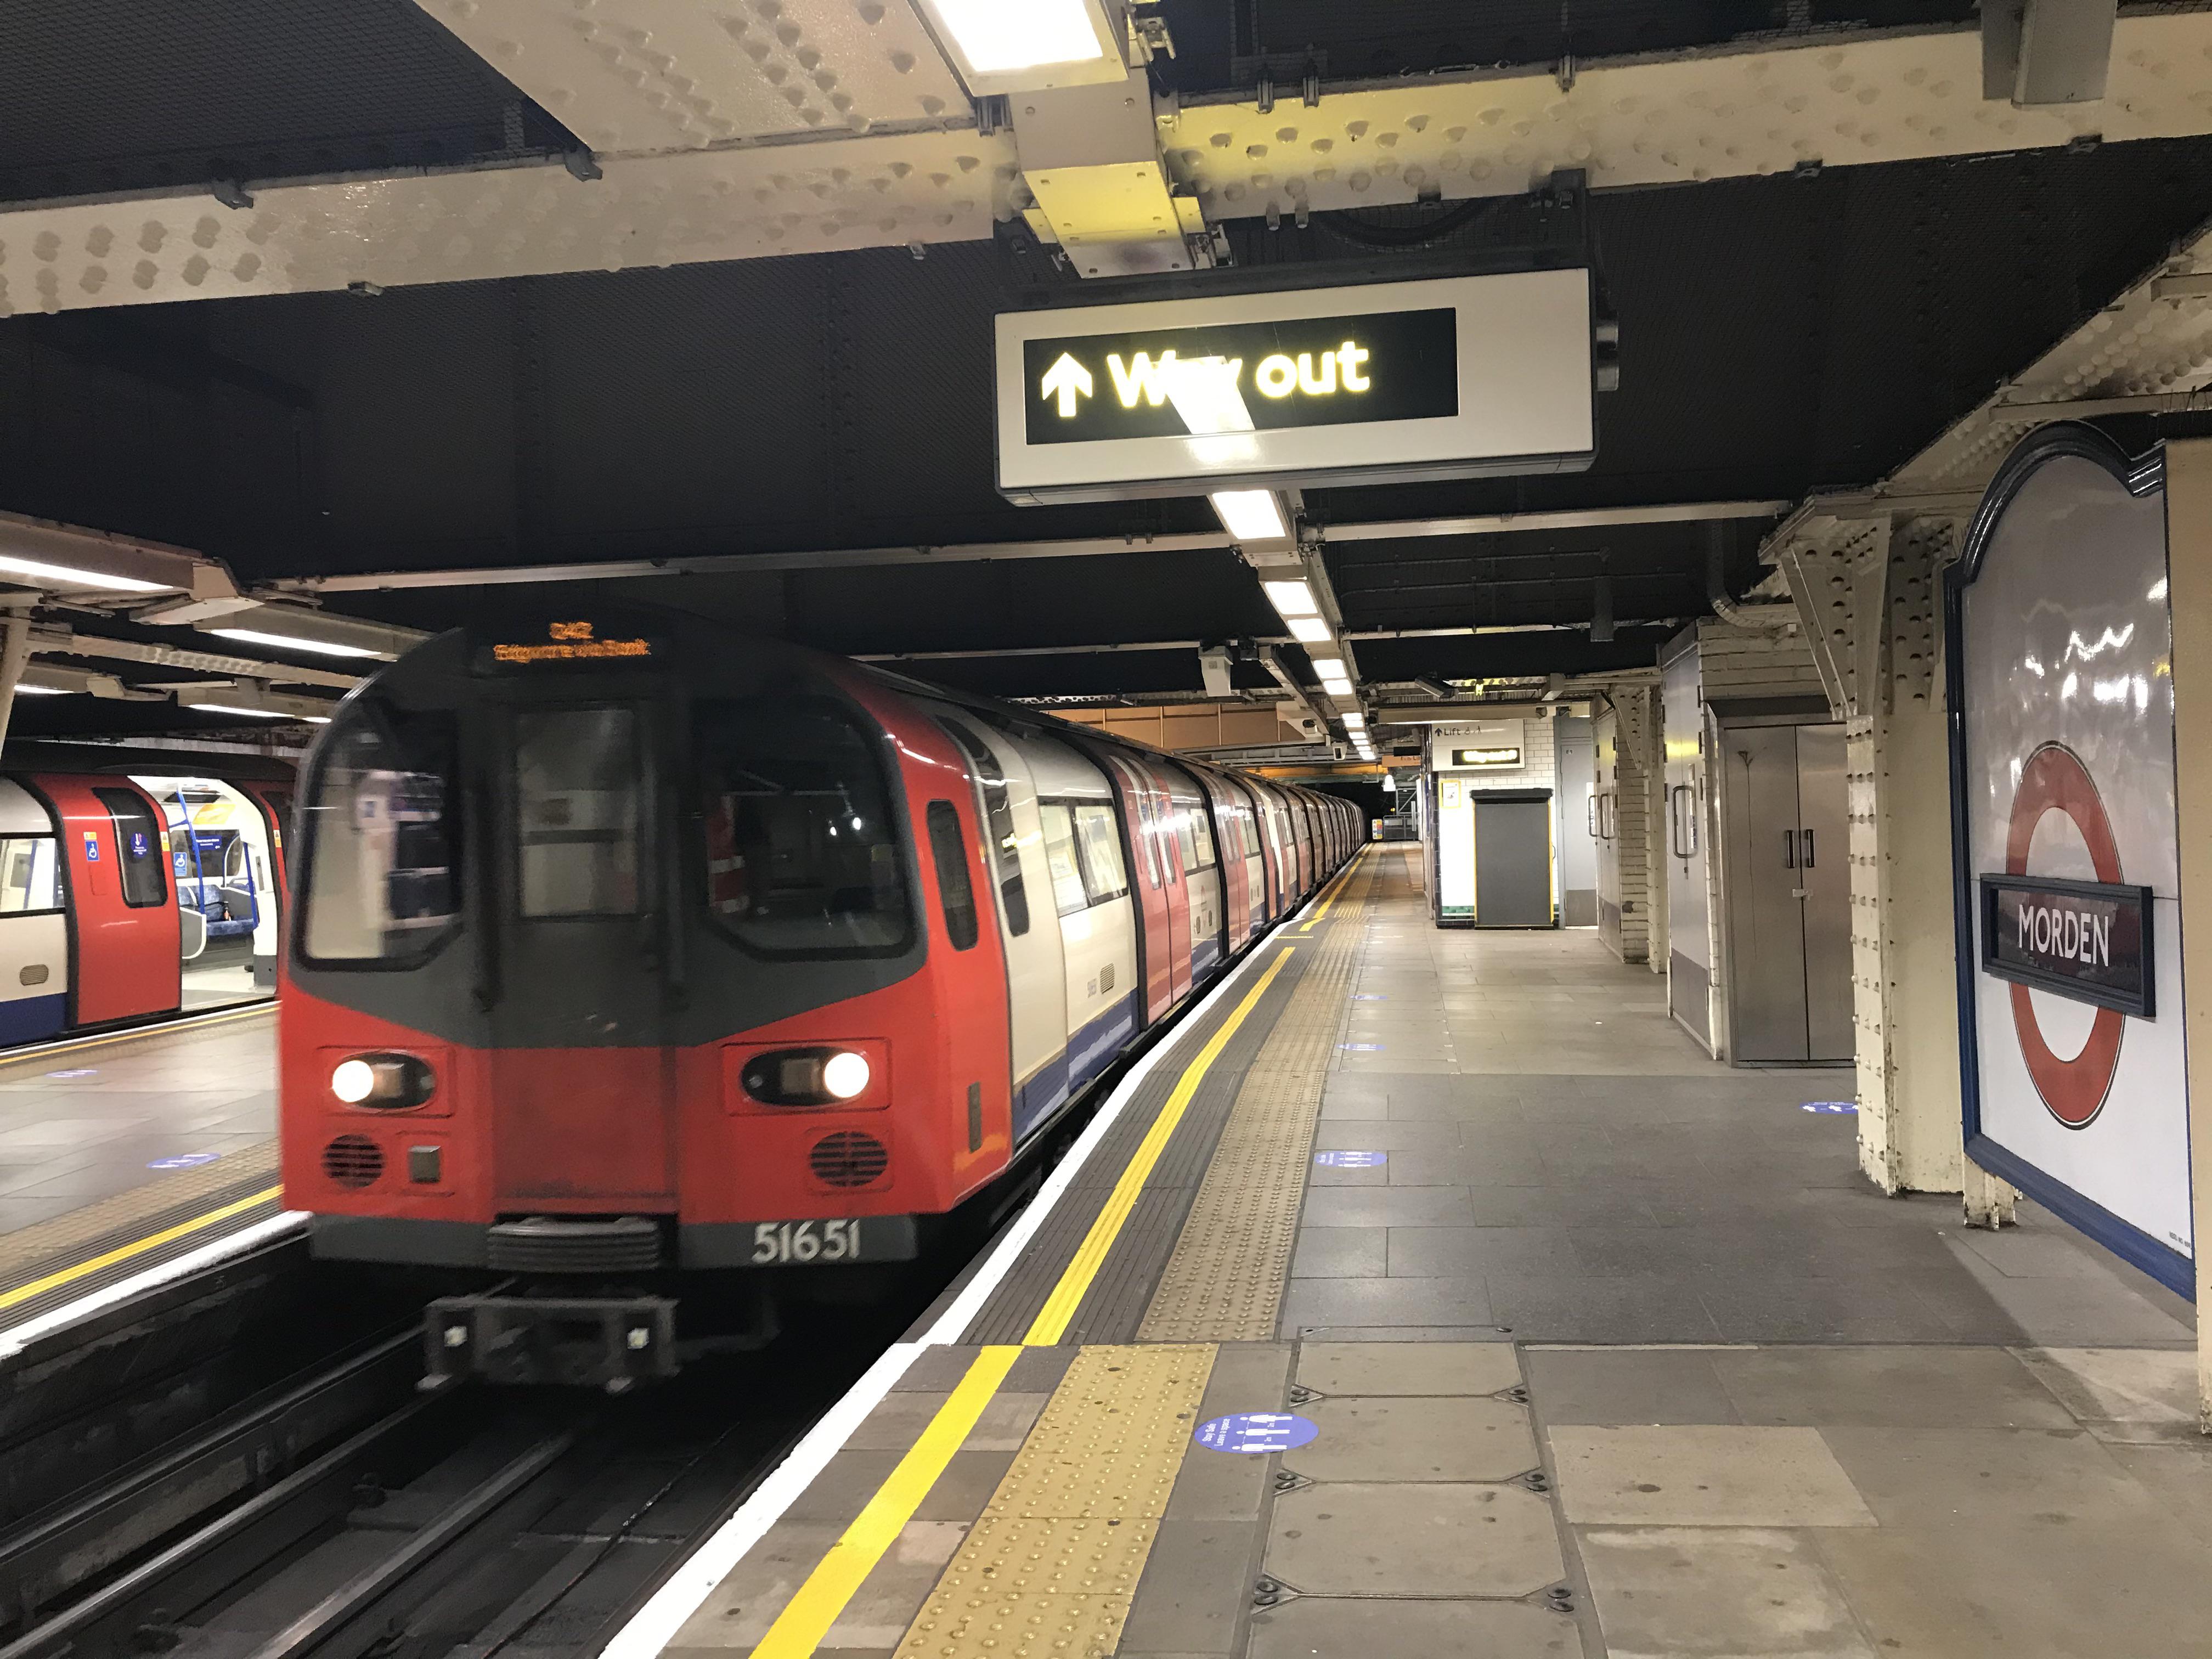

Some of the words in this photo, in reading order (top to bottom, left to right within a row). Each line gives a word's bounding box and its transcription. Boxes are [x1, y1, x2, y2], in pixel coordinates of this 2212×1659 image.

[1256, 341, 1370, 398] out
[2018, 904, 2109, 967] MORDEN
[751, 1218, 860, 1263] 51651
